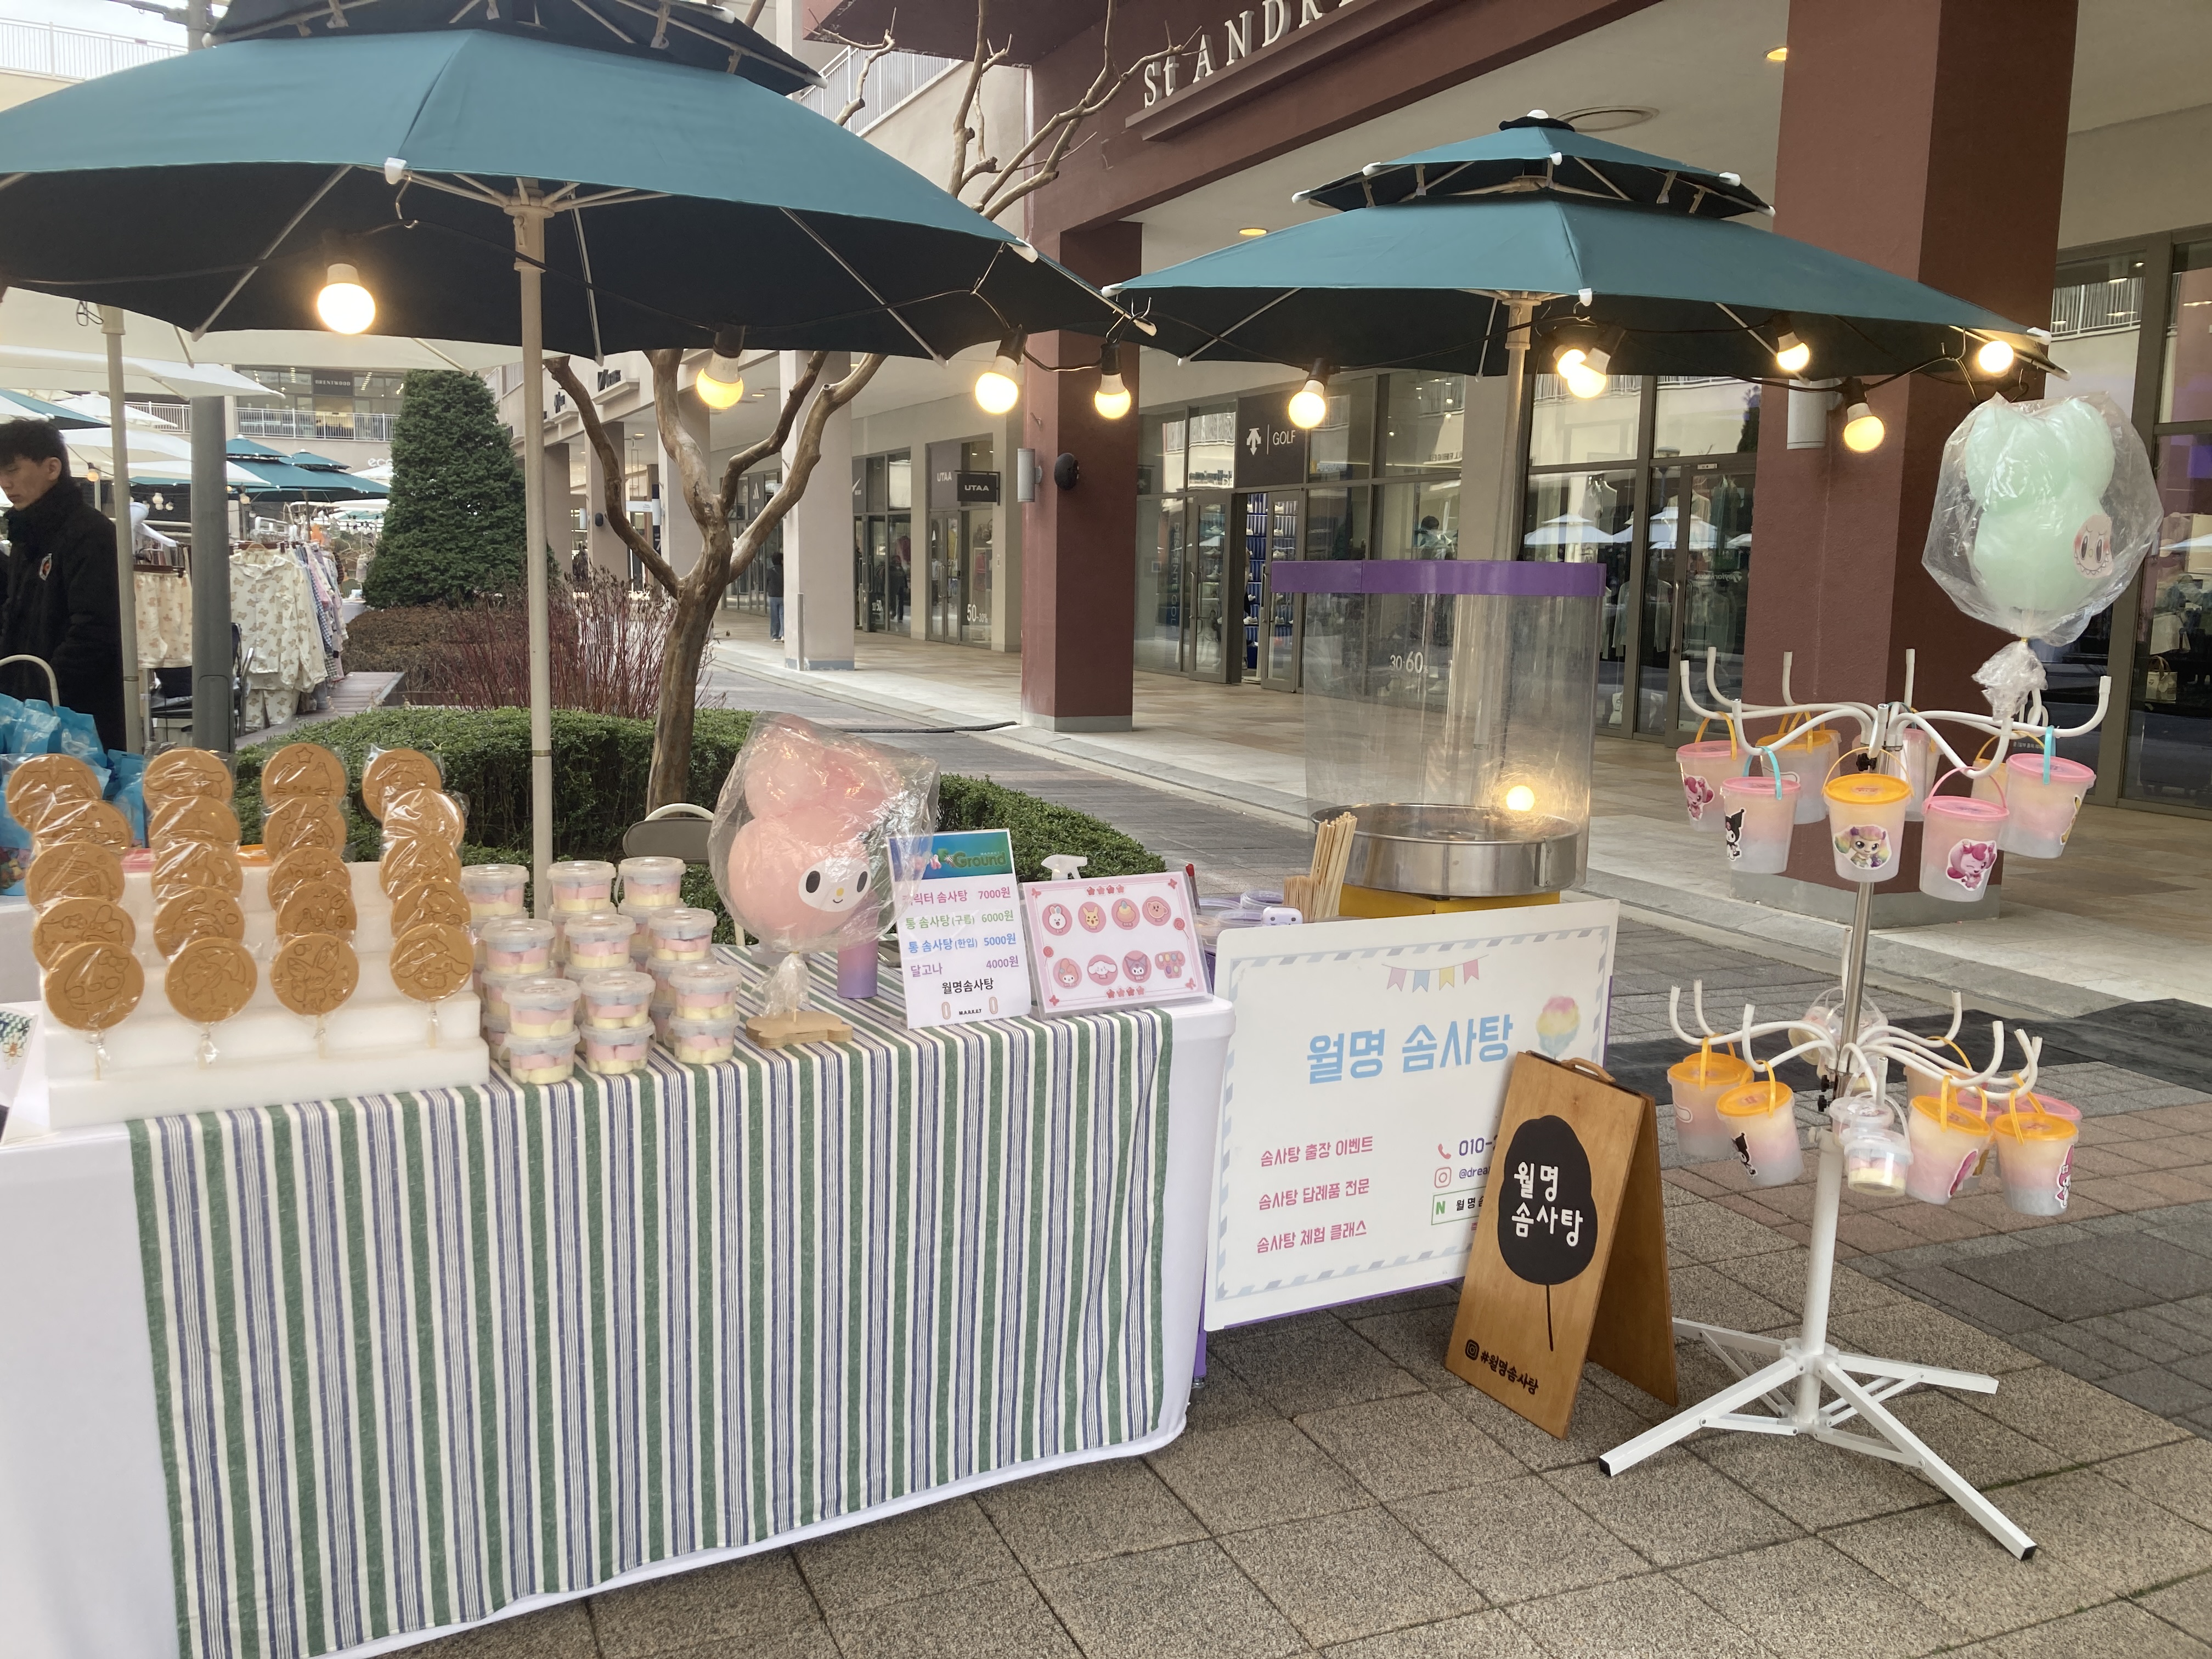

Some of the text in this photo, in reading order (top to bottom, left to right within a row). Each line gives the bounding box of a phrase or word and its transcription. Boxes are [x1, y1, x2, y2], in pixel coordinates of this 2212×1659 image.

[1144, 55, 1179, 109] St
[1273, 430, 1296, 445] GOLF
[937, 472, 952, 482] UTAA
[953, 851, 1006, 868] Ground
[937, 890, 968, 904] 솜사탕
[978, 887, 1011, 899] 7000원
[905, 918, 916, 929] 통
[981, 910, 1014, 923] 6000원
[908, 941, 918, 953] 통
[984, 933, 1017, 946] 5000원
[911, 956, 1019, 977] 달고나 4000원
[942, 978, 994, 994] 월명솜사탕
[1307, 1014, 1513, 1084] 월명 솜사탕
[1261, 1136, 1373, 1167] 솜사탕 출장 이벤트
[1459, 1166, 1491, 1179] @drea
[1514, 1161, 1559, 1202] 월명
[1259, 1178, 1369, 1210] 솜사탕 답례품 전문
[1511, 1203, 1584, 1247] 솜사탕
[1257, 1220, 1367, 1254] 솜사탕 체험 클래스
[1481, 1350, 1539, 1395] #월명솜사탕
